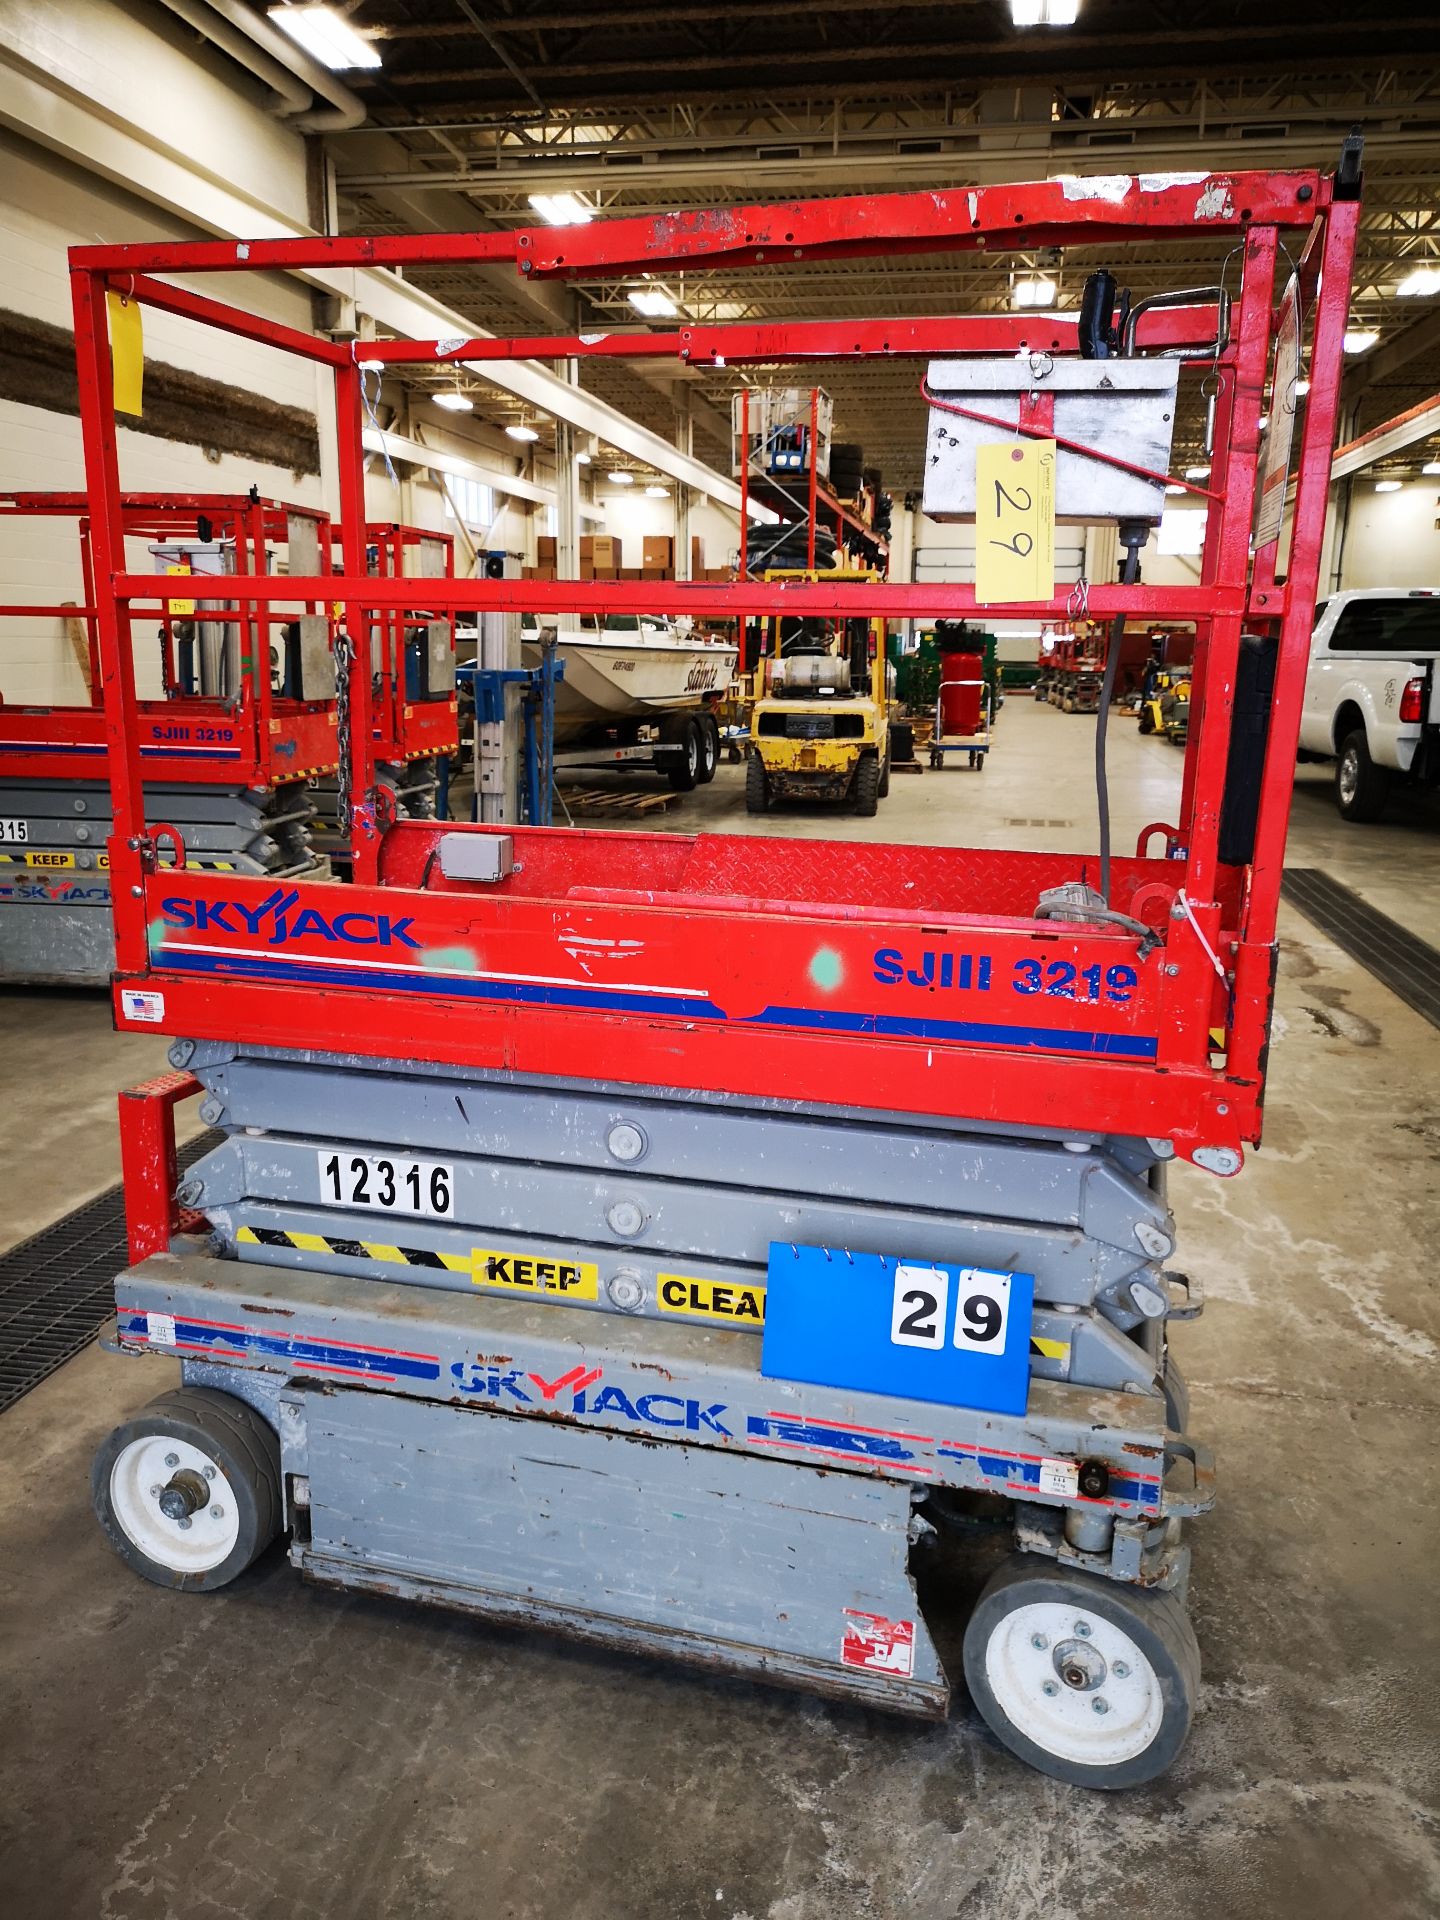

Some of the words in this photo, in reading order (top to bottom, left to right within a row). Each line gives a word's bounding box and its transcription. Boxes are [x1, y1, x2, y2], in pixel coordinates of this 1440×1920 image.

[152, 726, 190, 740] SJIII
[195, 727, 234, 742] 3219
[32, 854, 69, 866] KEEP
[161, 888, 424, 949] SKYJACK
[873, 948, 992, 991] SJIII
[1012, 958, 1138, 1002] 3219
[326, 1155, 450, 1214] 12316
[487, 1256, 582, 1291] KEEP
[662, 1280, 767, 1320] CLEA
[450, 1362, 734, 1437] SKYJACK
